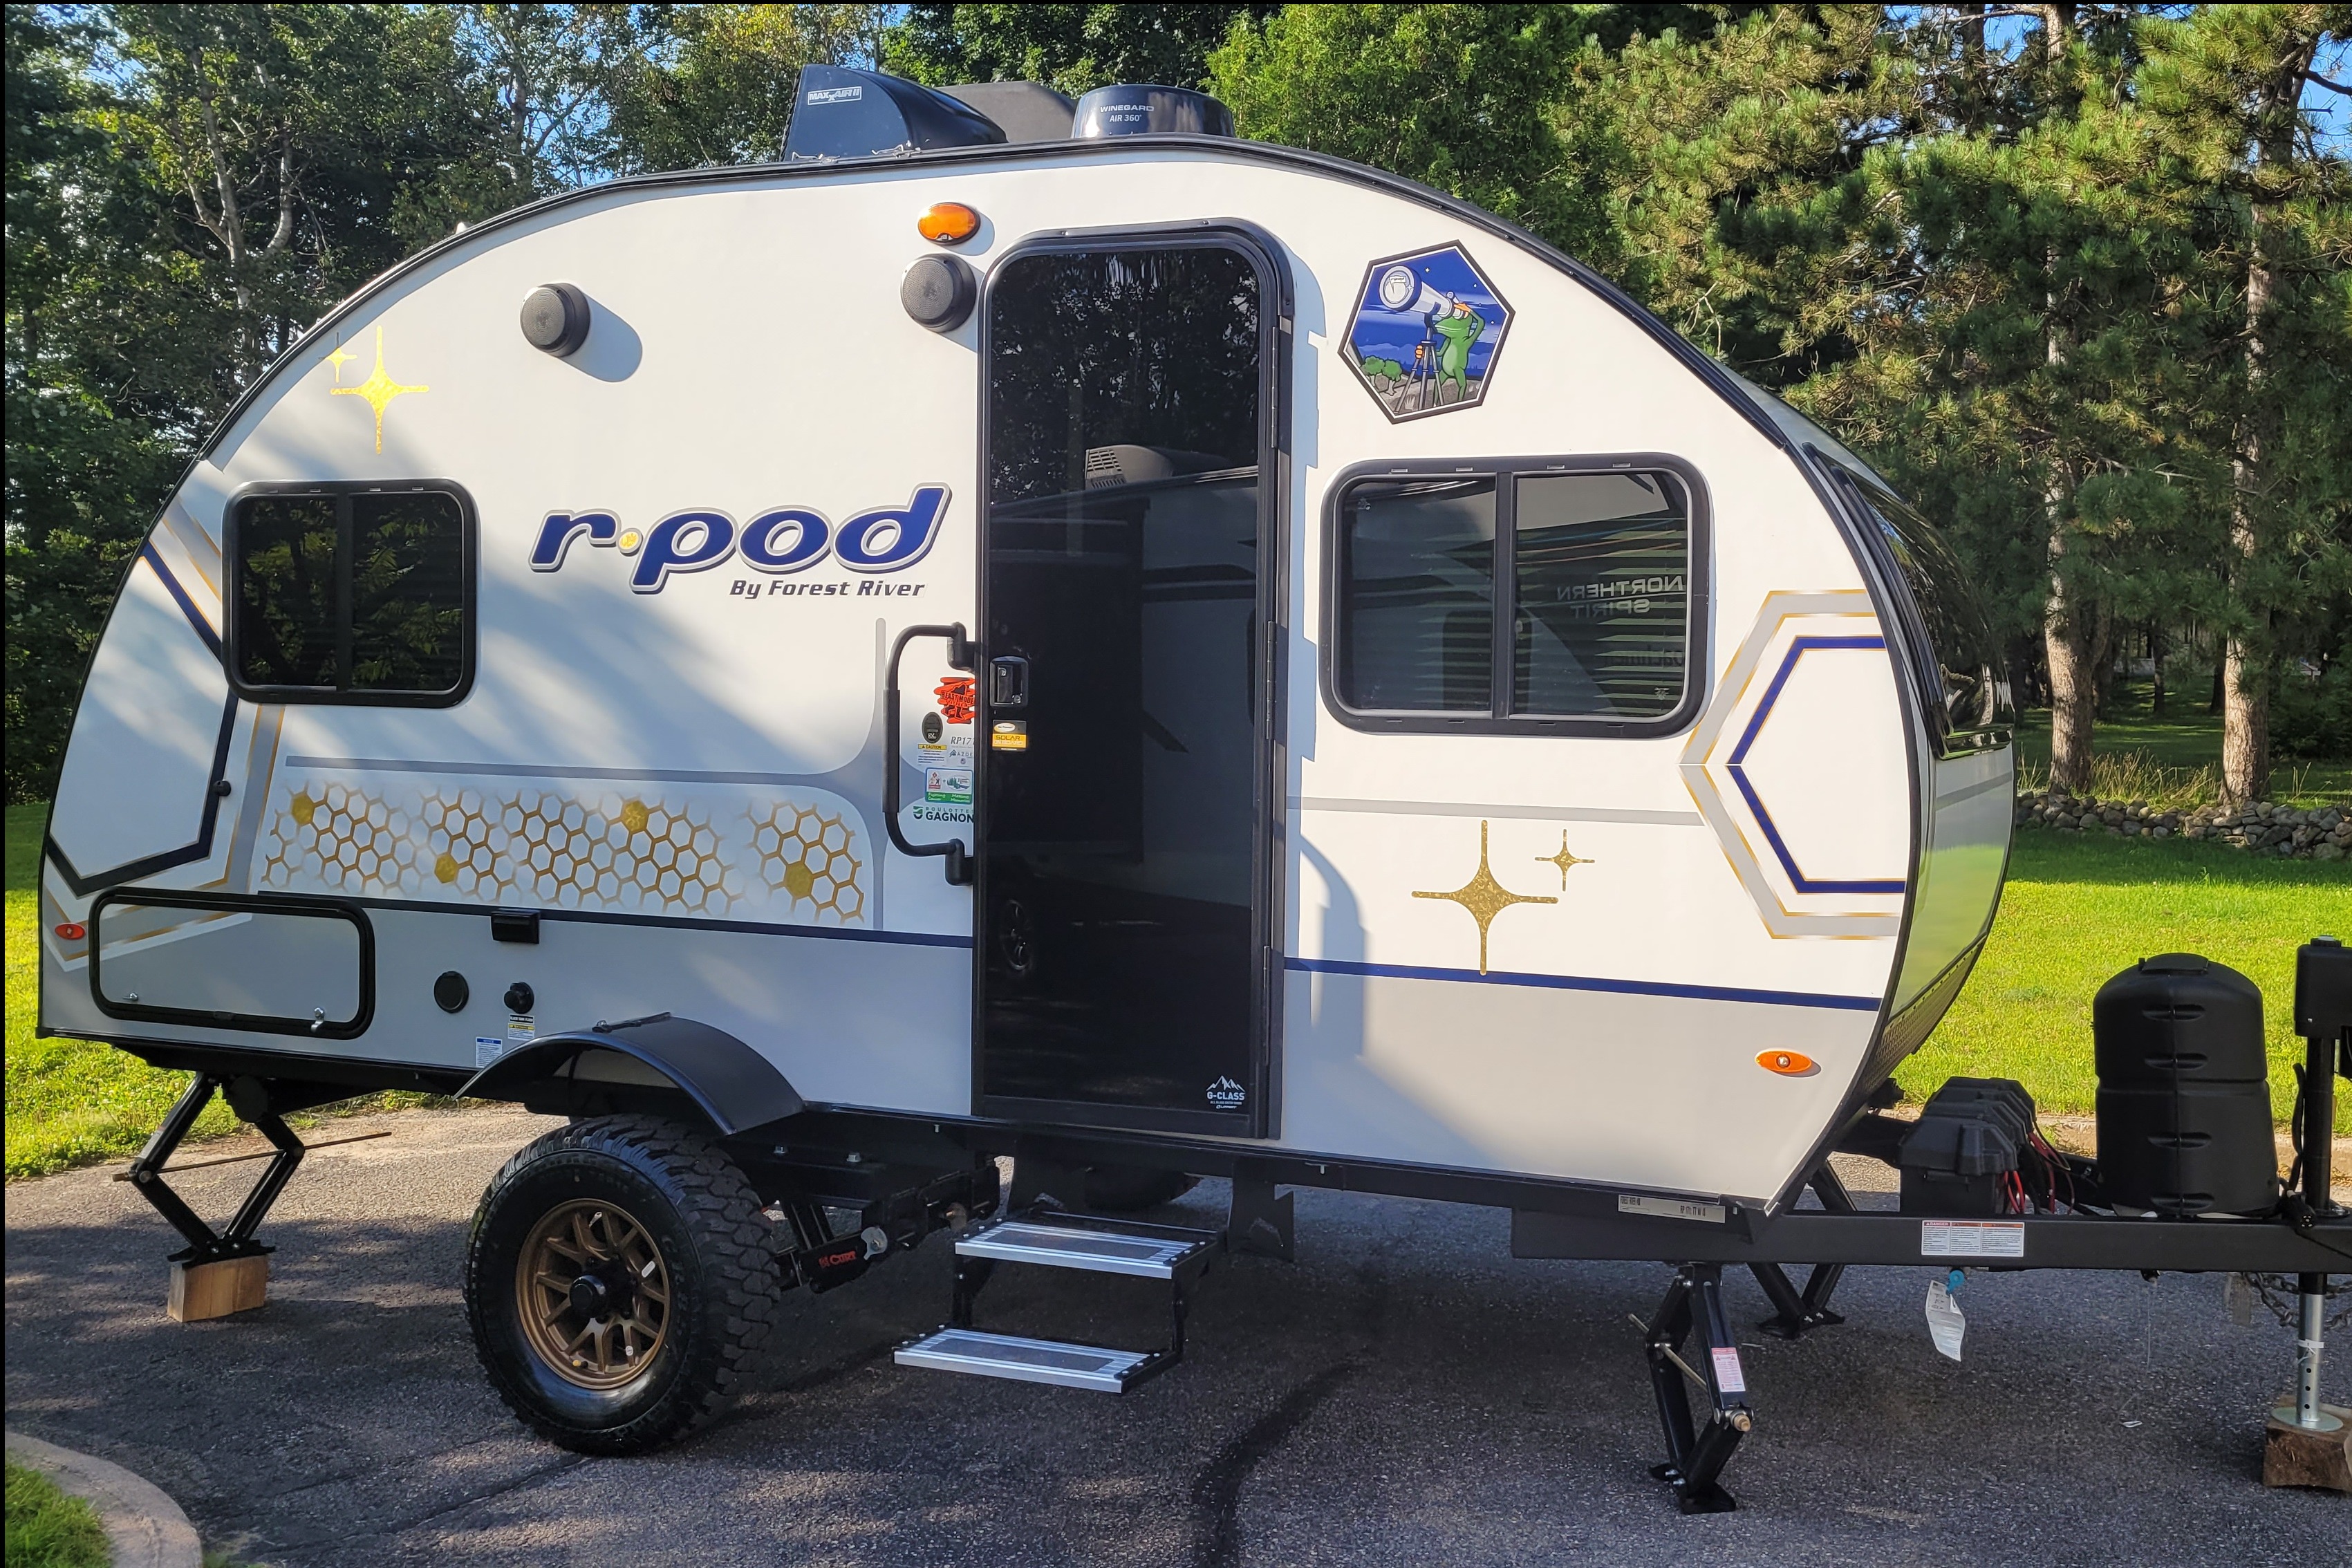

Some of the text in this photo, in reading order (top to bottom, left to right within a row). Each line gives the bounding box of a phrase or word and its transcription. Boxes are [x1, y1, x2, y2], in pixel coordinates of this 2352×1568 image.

[1100, 104, 1155, 113] WINEGARD
[1109, 114, 1123, 122] AIR
[729, 579, 926, 599] By Forest River
[941, 691, 958, 701] BEAST
[958, 694, 974, 704] MODE
[925, 811, 974, 823] GAGNON
[1206, 1091, 1245, 1101] G-CLASS
